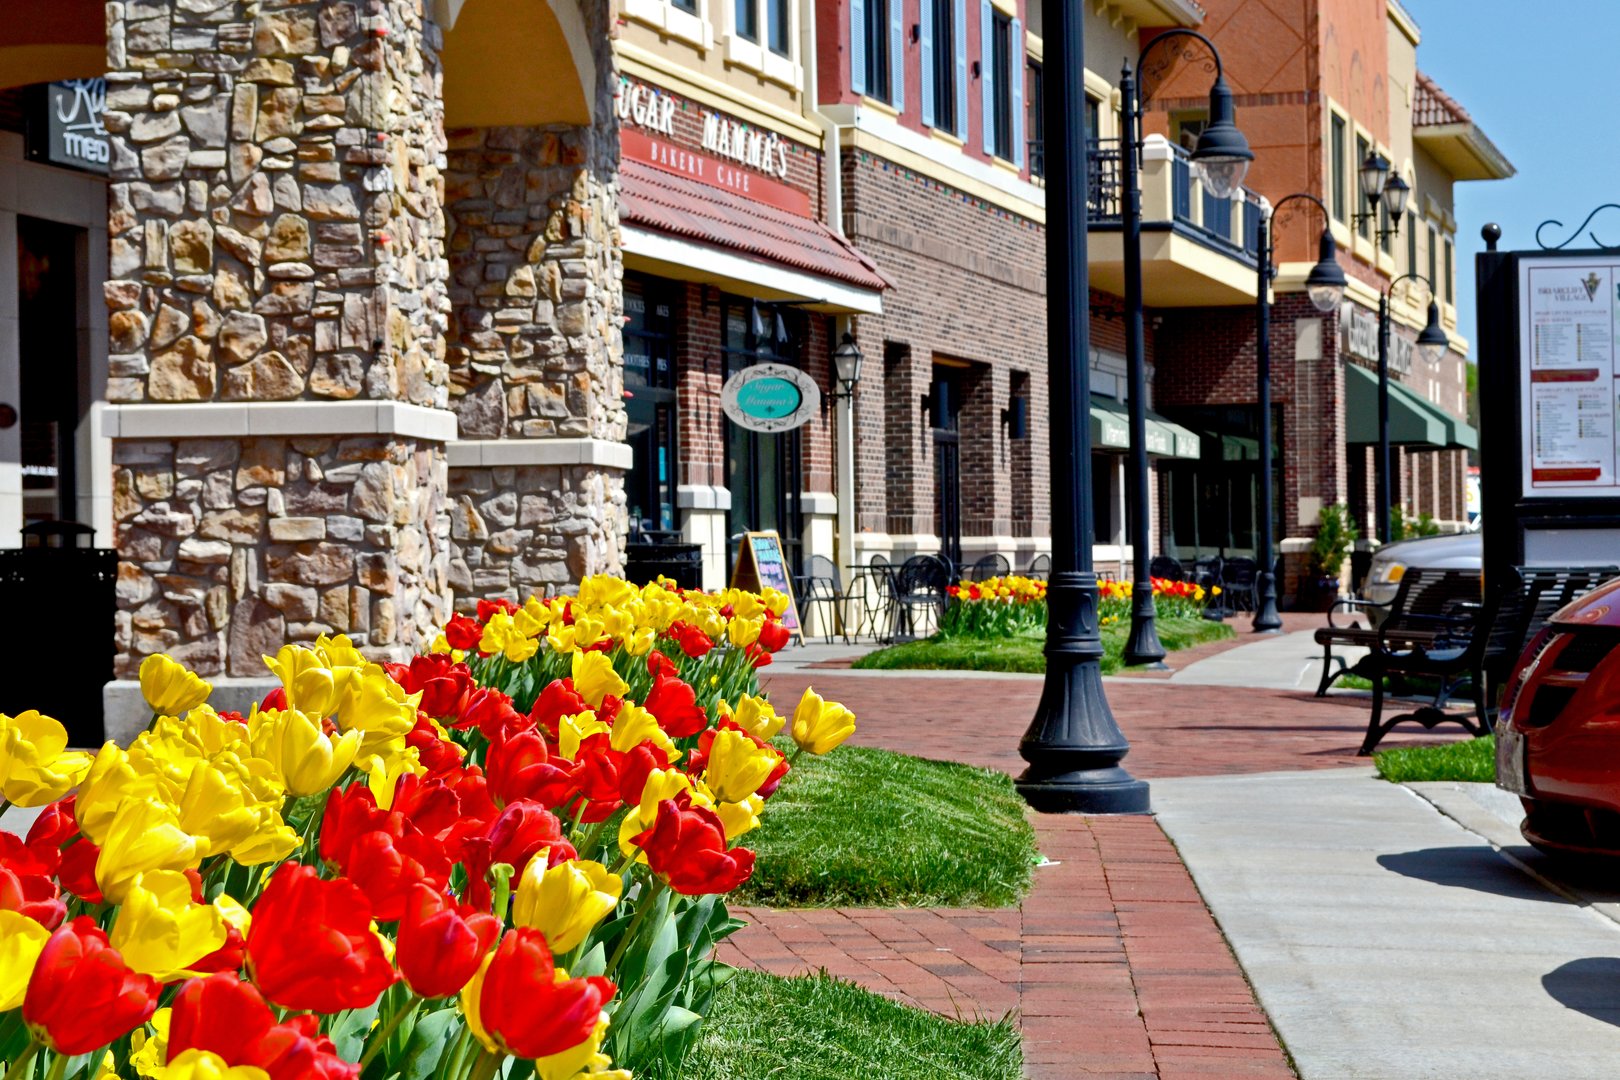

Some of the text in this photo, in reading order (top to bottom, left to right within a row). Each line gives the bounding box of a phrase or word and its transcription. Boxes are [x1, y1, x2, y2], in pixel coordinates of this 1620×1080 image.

[618, 82, 787, 177] UGAR MAMMA'S
[651, 141, 750, 192] BAKERY CAFE
